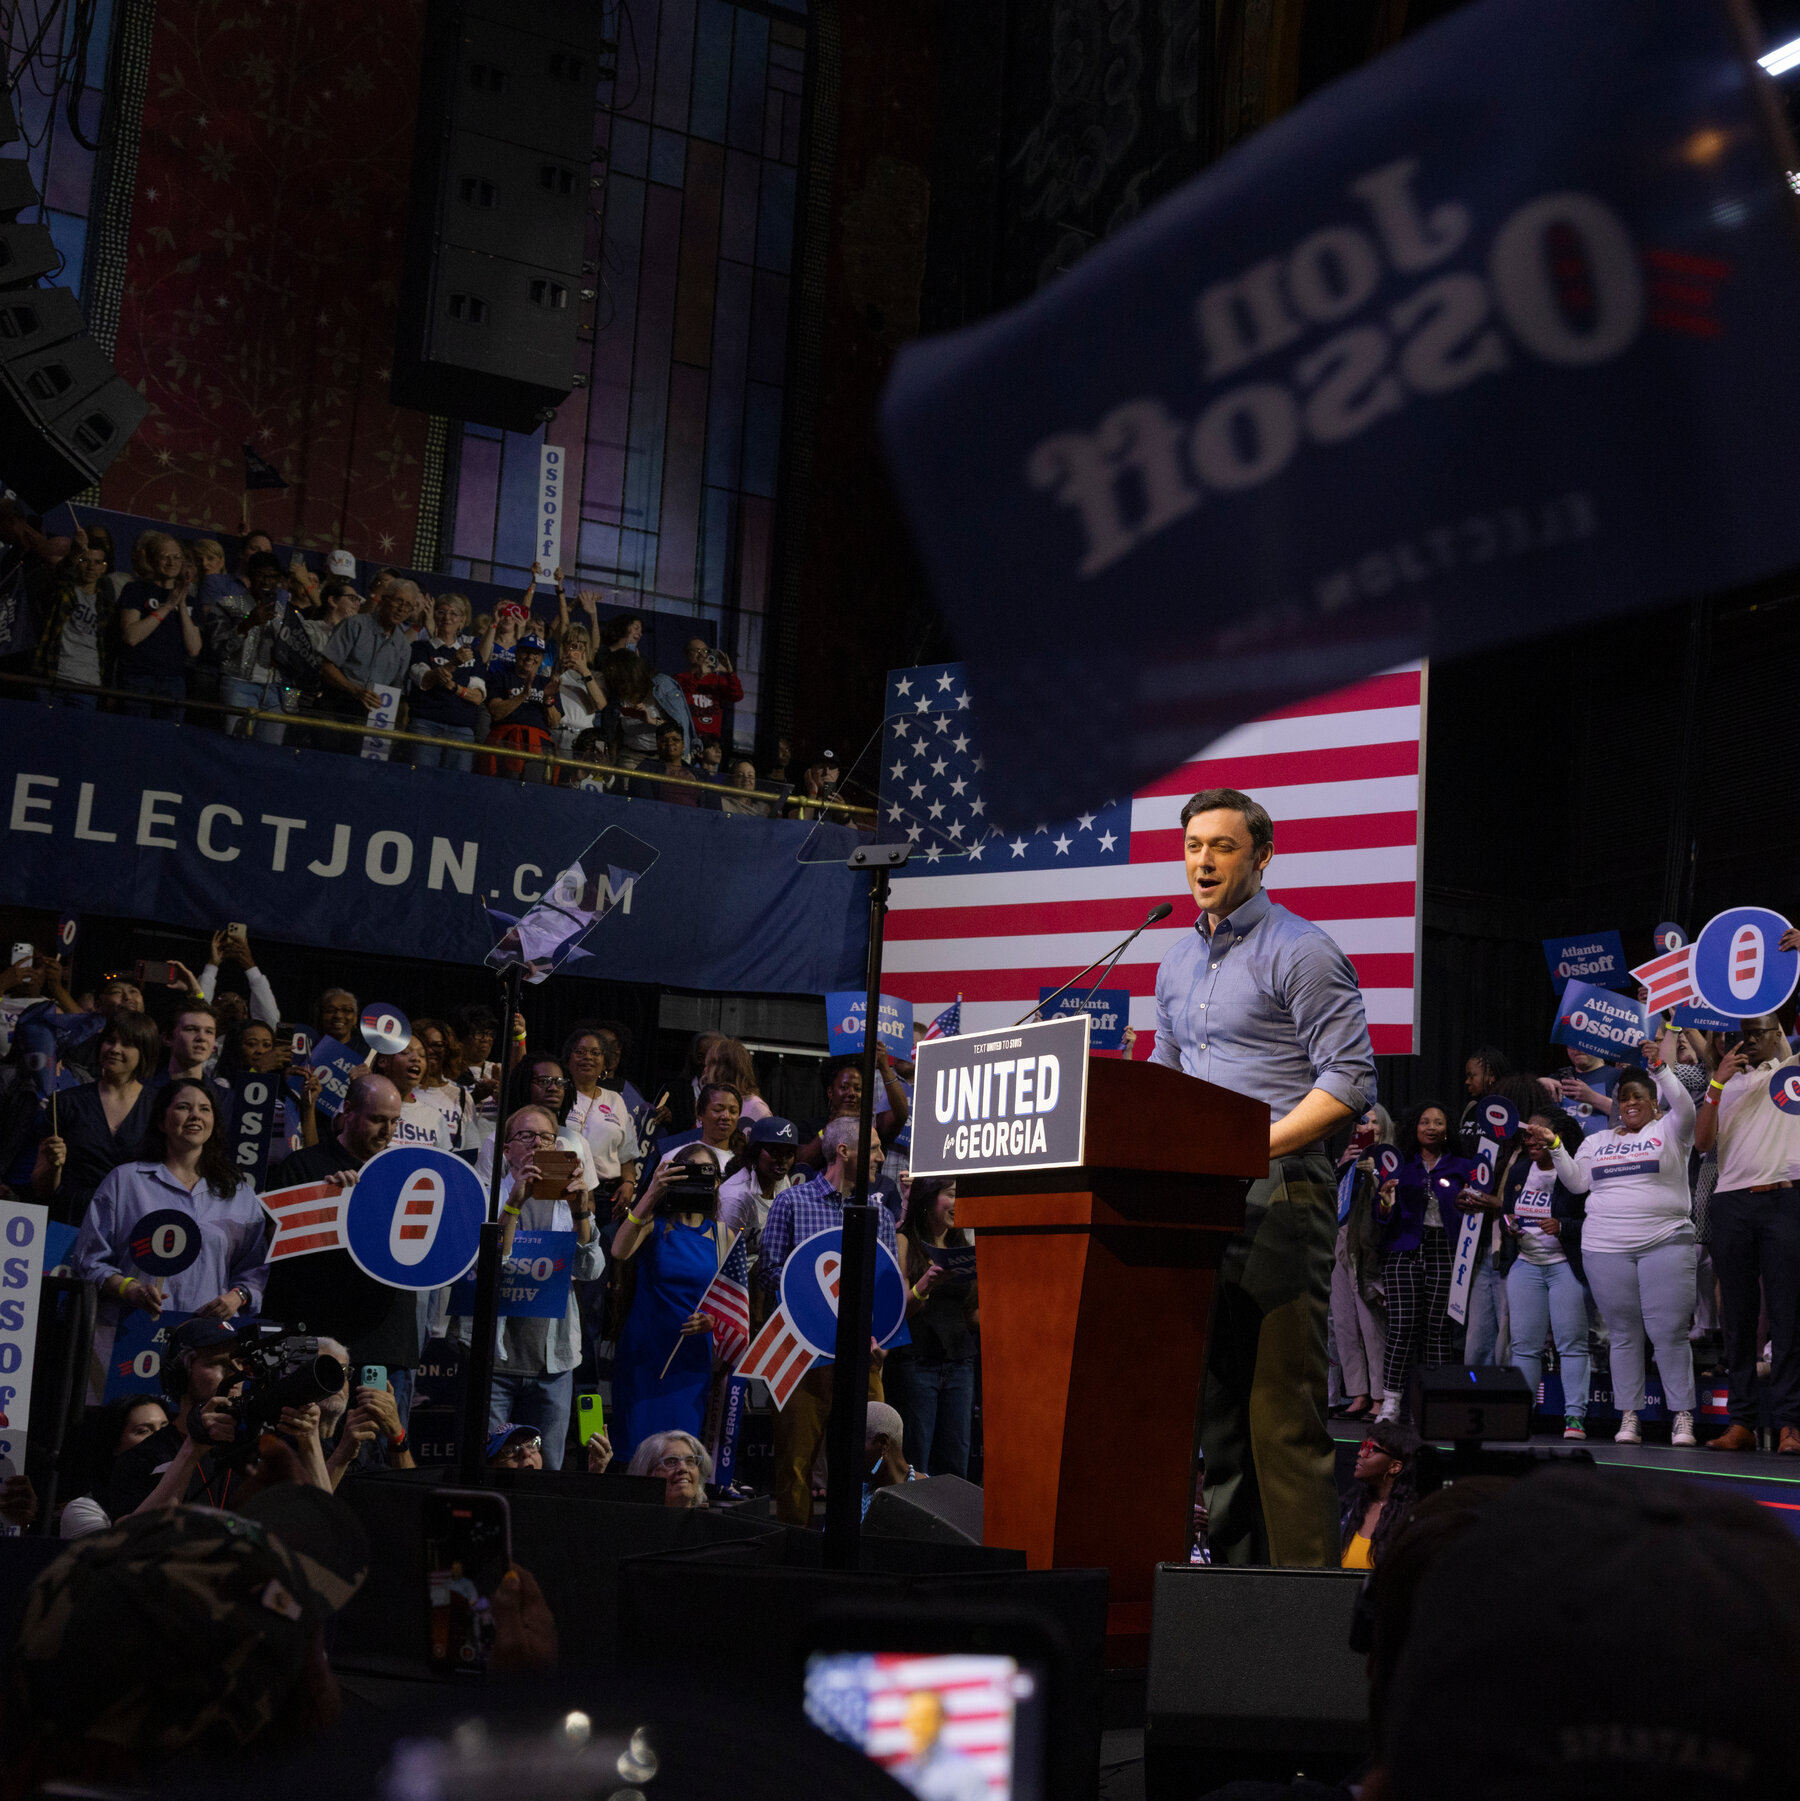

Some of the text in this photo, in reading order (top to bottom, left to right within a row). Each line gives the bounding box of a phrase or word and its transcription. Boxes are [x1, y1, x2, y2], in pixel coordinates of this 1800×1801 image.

[1560, 943, 1605, 958] Atlanta
[1558, 954, 1616, 978] Ossoff
[1583, 997, 1640, 1025] Atlanta
[1601, 1014, 1613, 1024] for
[1569, 1010, 1645, 1048] Ossoff
[973, 1043, 986, 1054] TEXT
[1002, 1039, 1010, 1049] TO
[934, 1054, 1061, 1125] UNITED
[776, 1123, 793, 1138] A
[942, 1117, 1048, 1160] for GEORGIA
[1594, 1140, 1656, 1157] KEISHA
[1603, 1164, 1642, 1174] GOVERNOR
[721, 1385, 741, 1468] GOVERNOR
